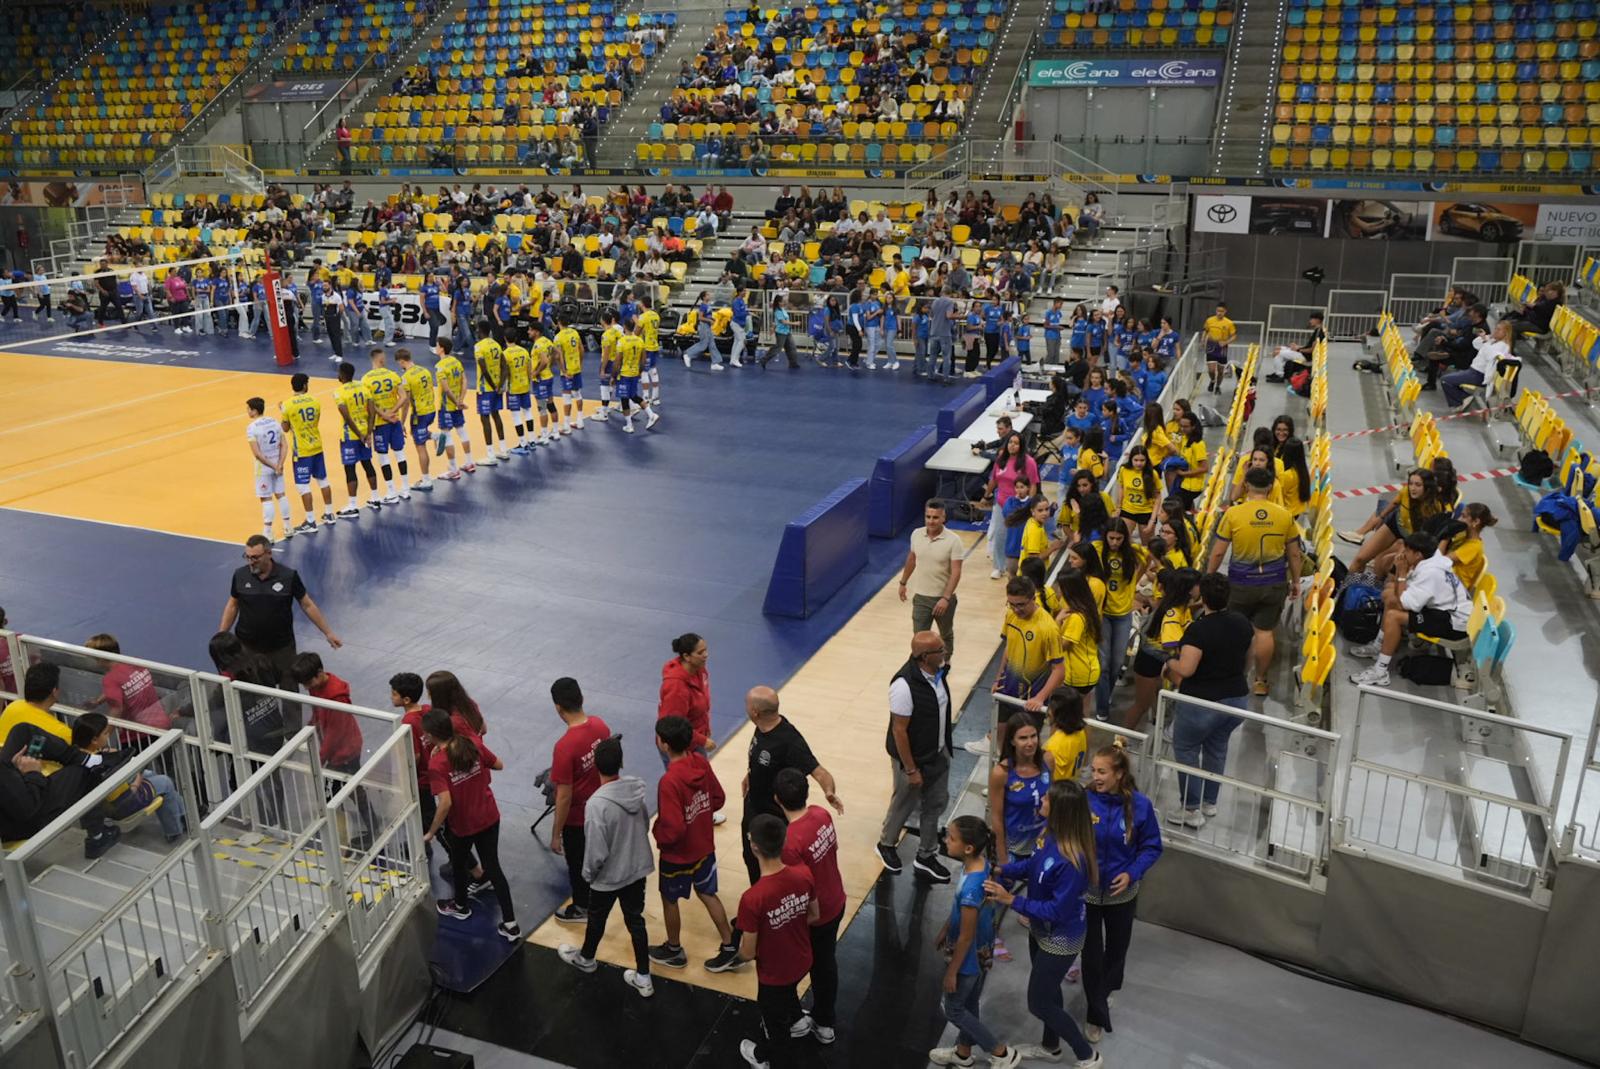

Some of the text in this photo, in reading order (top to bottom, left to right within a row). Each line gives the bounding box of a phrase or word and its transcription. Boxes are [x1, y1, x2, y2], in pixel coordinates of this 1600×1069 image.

[1547, 211, 1597, 223] NUEVO
[514, 356, 525, 367] 27
[372, 378, 394, 394] 23
[421, 375, 427, 389] 5
[353, 391, 365, 406] 11
[298, 406, 316, 422] 18
[267, 430, 276, 444] 2
[1128, 493, 1143, 504] 22
[1109, 580, 1118, 592] 6
[1032, 789, 1039, 806] 1
[781, 893, 796, 905] CLUB
